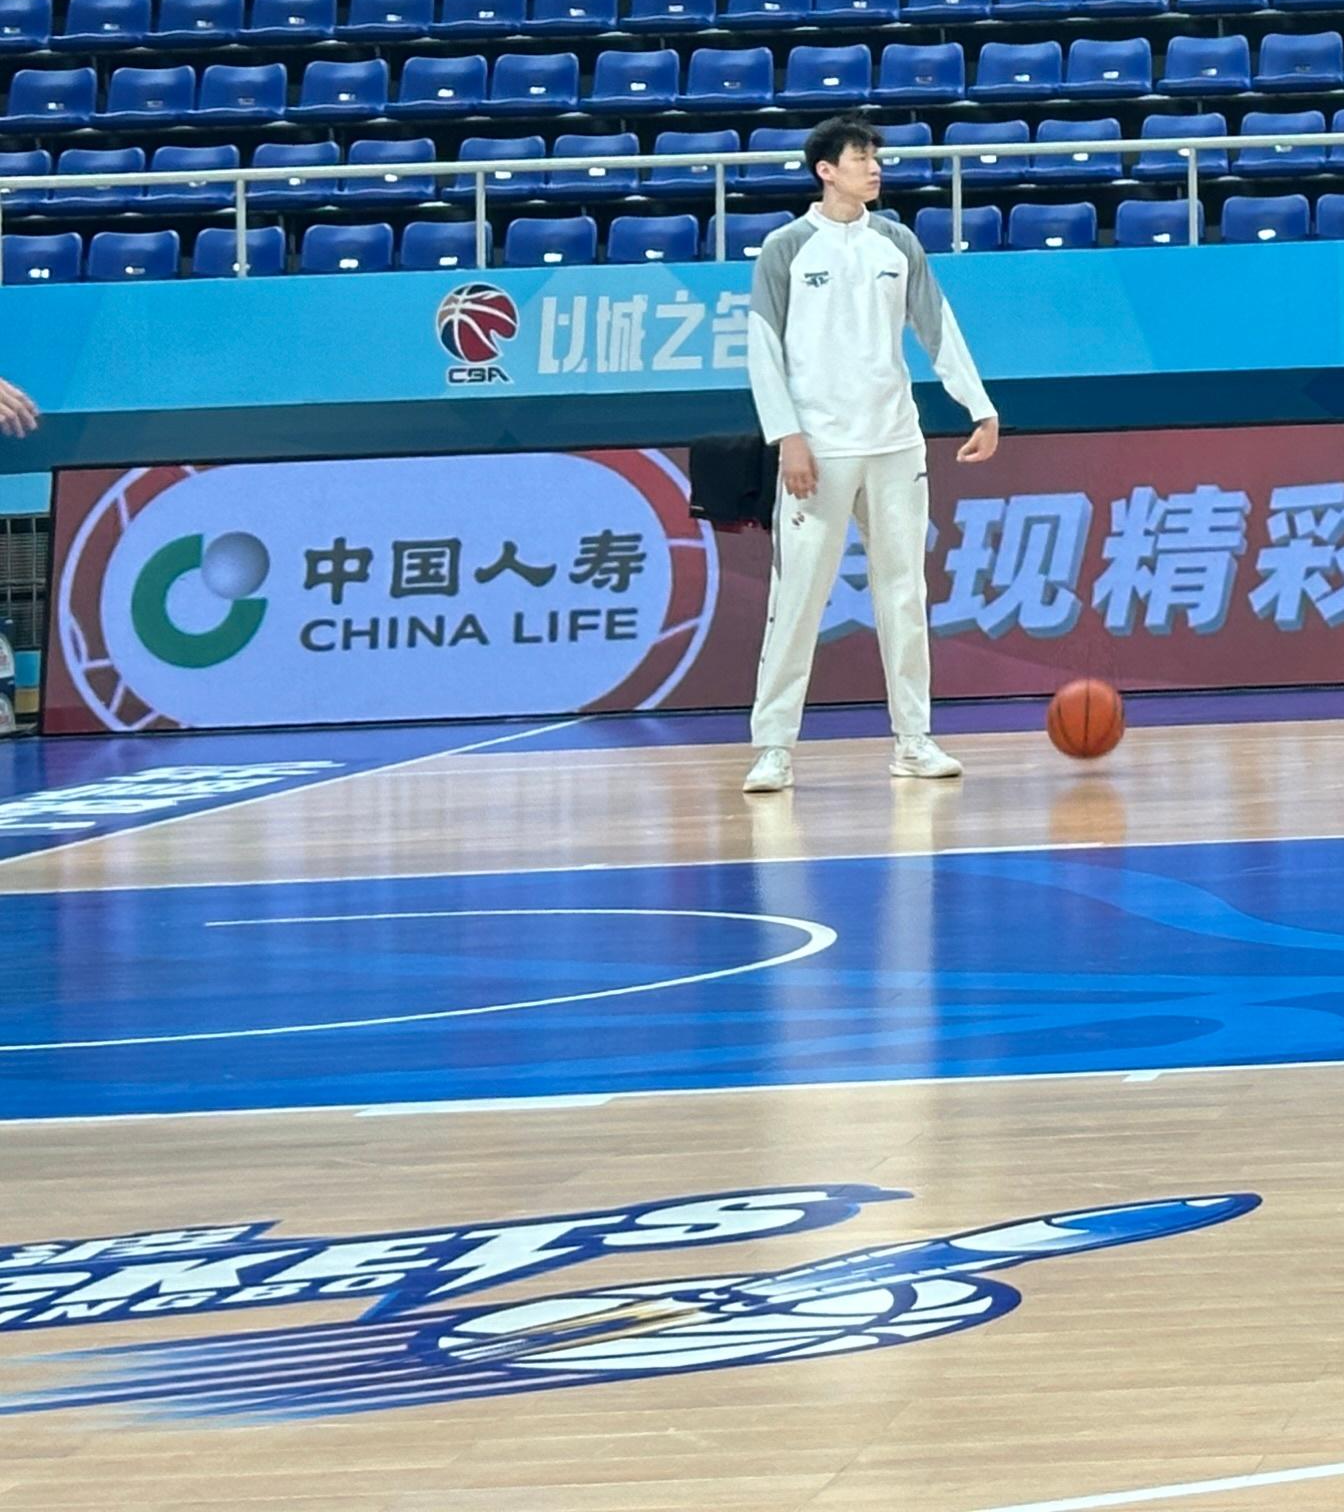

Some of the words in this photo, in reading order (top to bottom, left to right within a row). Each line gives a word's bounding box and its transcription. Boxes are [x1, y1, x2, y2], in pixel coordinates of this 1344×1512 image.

[447, 366, 511, 383] CBA
[303, 529, 647, 605] 中国人寿
[300, 612, 490, 653] CHINA
[513, 607, 639, 644] LIFE
